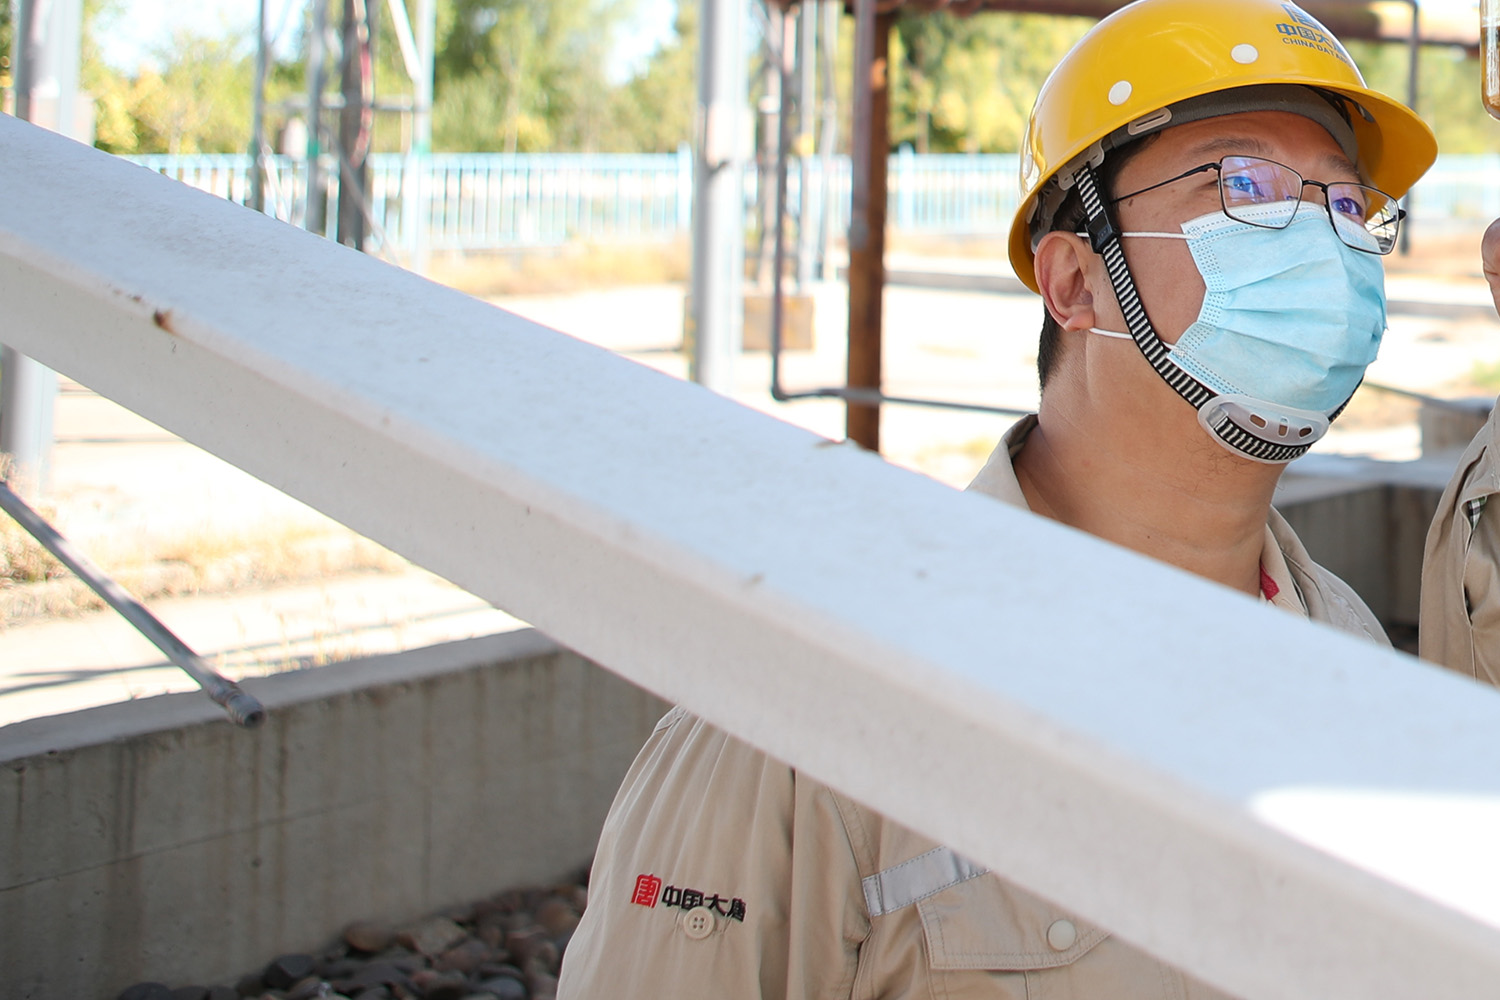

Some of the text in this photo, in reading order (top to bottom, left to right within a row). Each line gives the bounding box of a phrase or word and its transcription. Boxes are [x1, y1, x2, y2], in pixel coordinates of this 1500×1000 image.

[1282, 37, 1352, 67] CHINA DATA
[661, 885, 746, 922] 中国大唐
